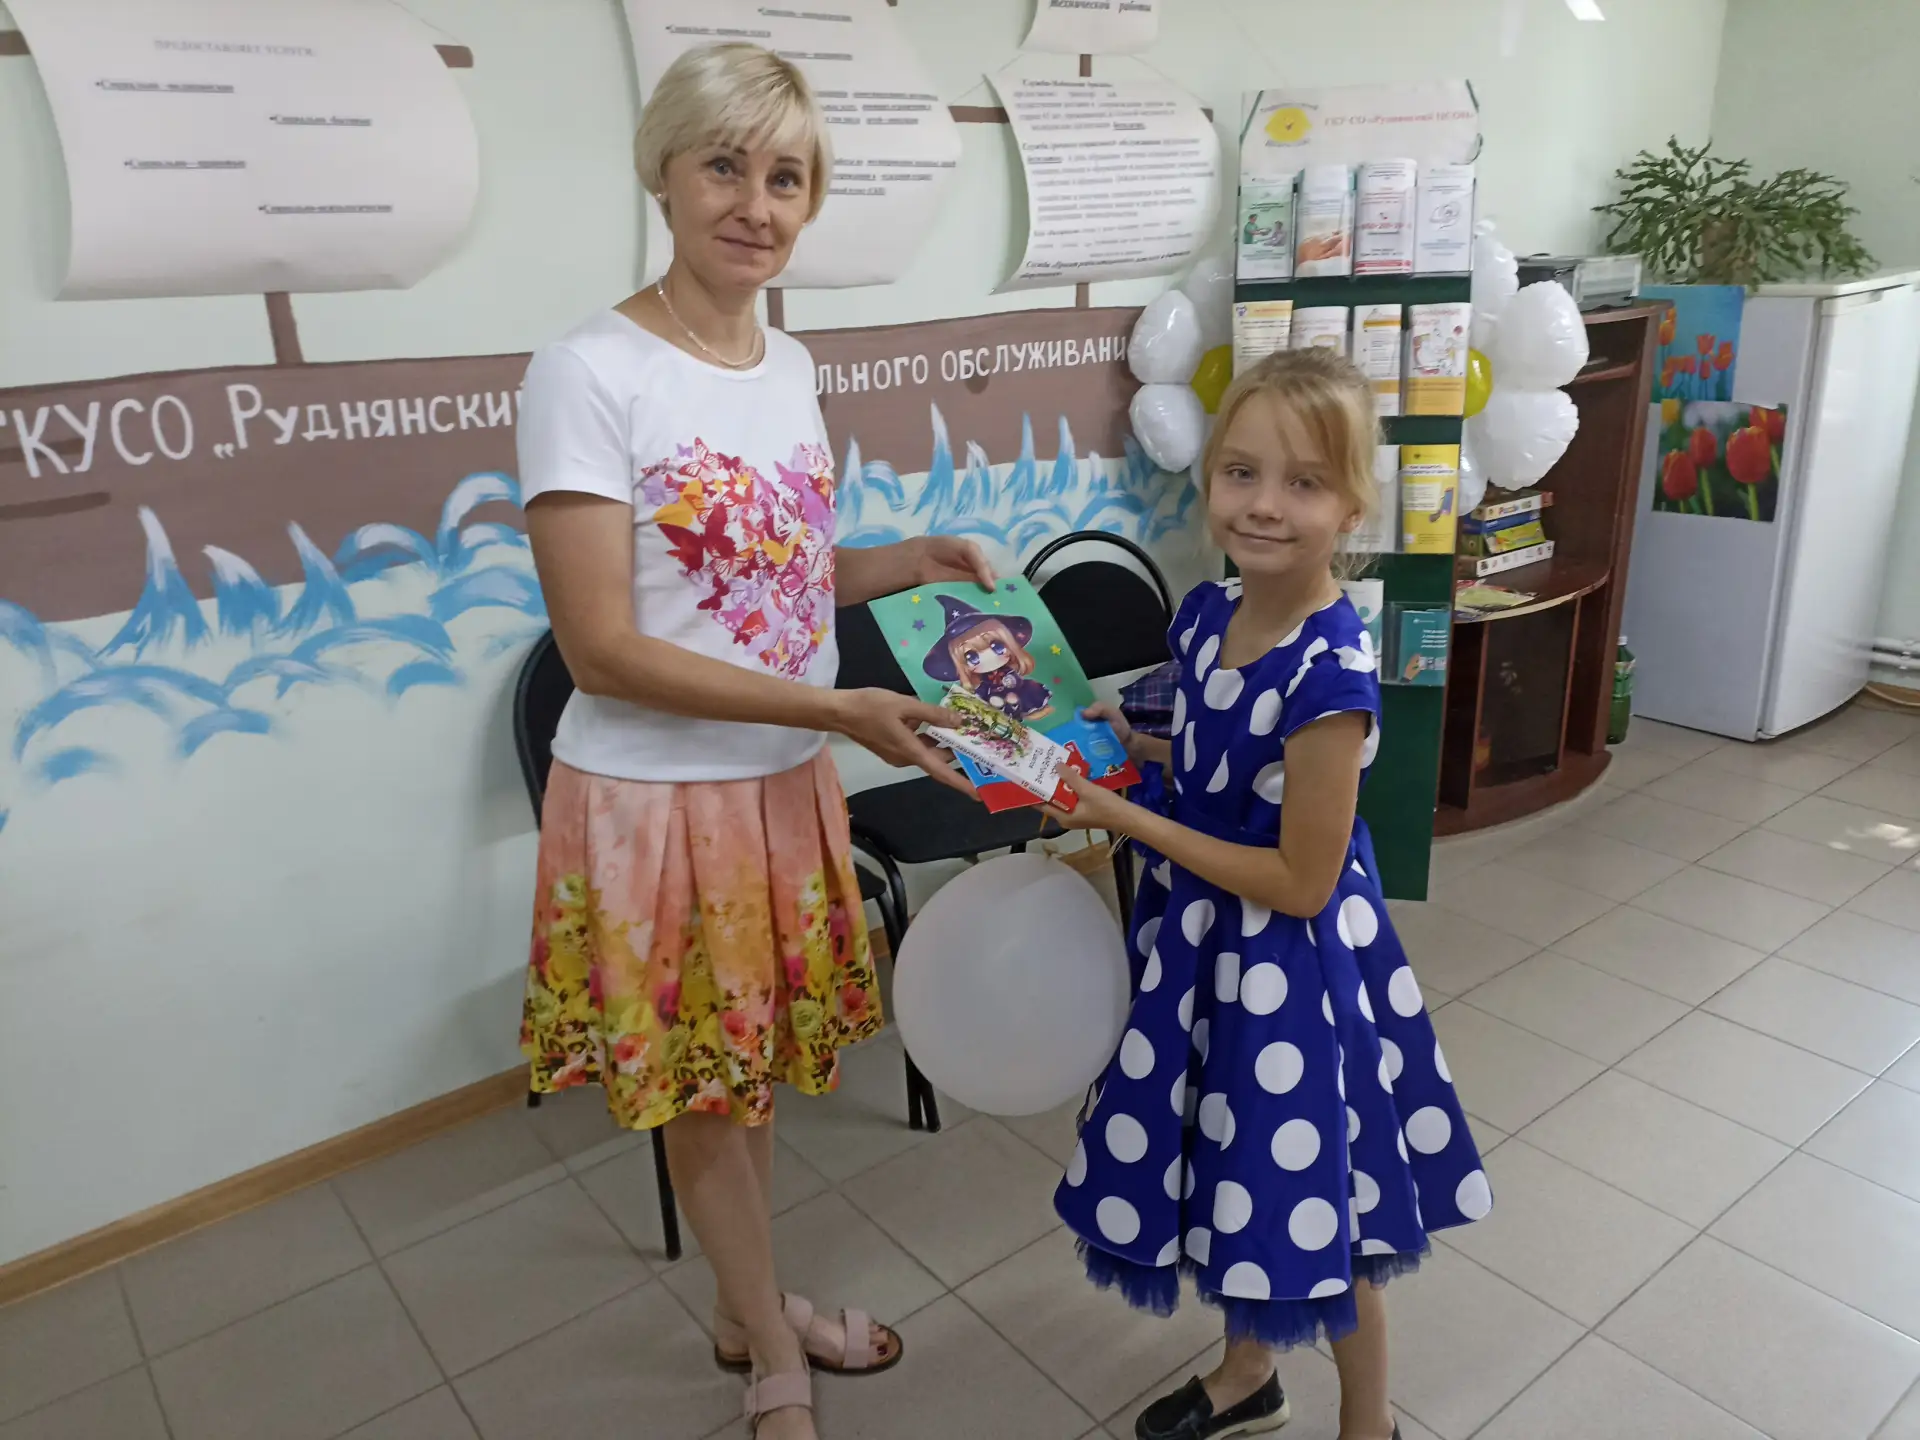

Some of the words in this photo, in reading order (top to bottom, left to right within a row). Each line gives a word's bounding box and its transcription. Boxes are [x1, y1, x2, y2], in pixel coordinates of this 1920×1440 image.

[0, 394, 194, 478] КУСО
[815, 354, 929, 395] ЛЬНОГО
[941, 336, 1127, 382] ОБСЛУЖИВАНИ
